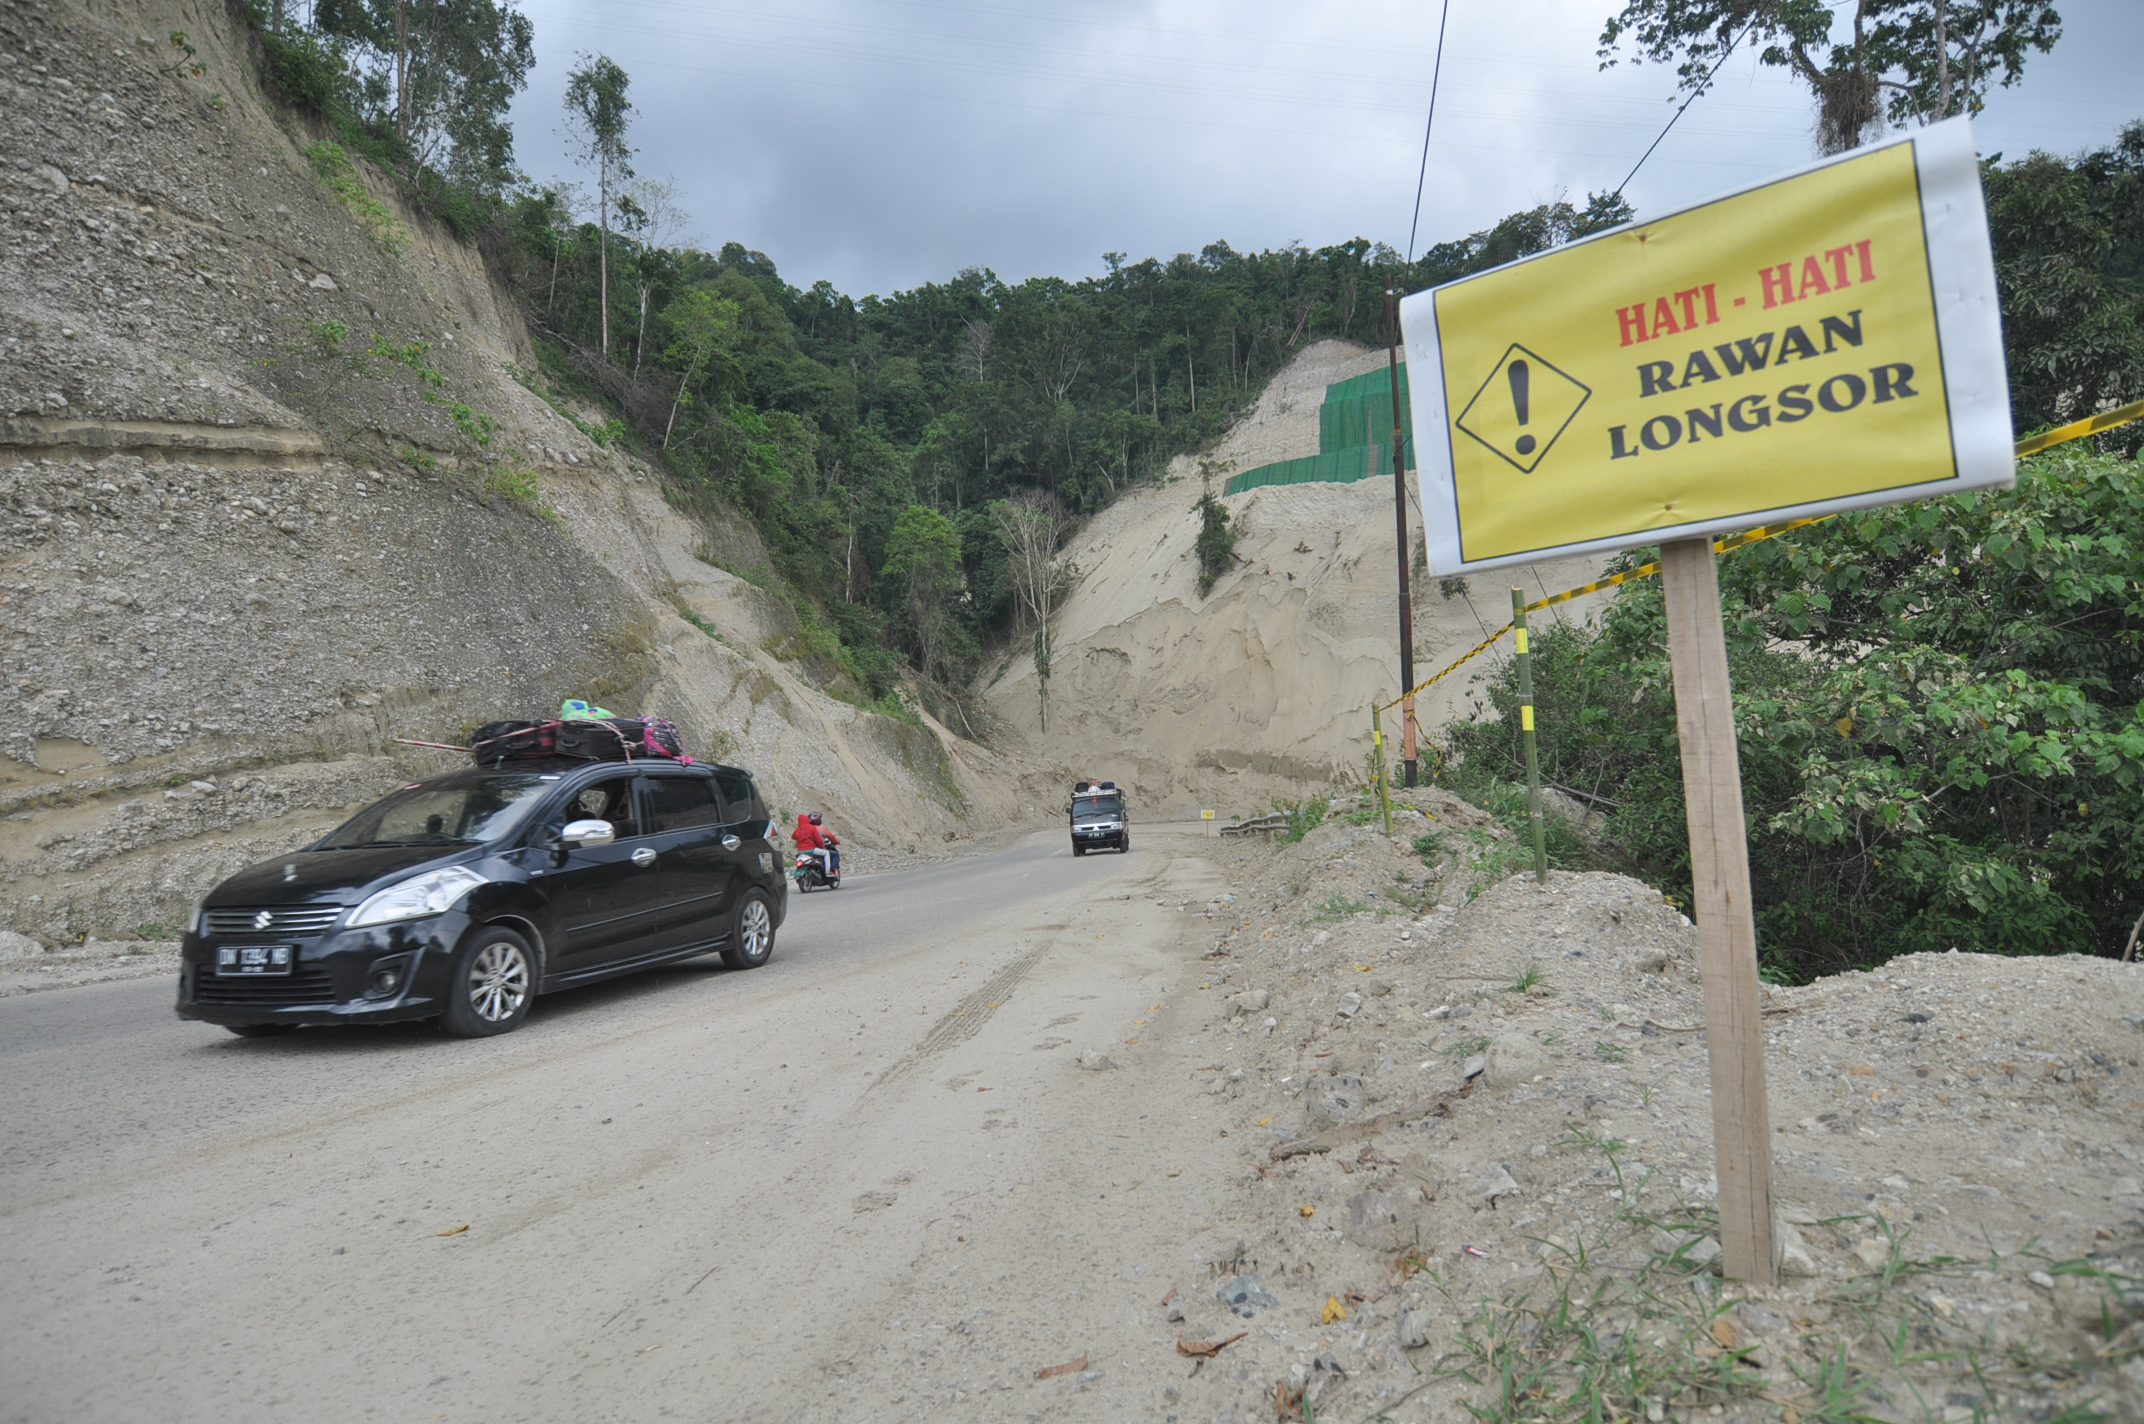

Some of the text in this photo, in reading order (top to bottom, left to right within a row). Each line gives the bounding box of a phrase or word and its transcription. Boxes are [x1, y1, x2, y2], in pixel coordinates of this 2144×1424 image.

[1616, 284, 1719, 347] HATI
[1759, 240, 1876, 309] HATI
[1638, 309, 1863, 398] RAWAN
[1608, 363, 1918, 460] LONGSOR
